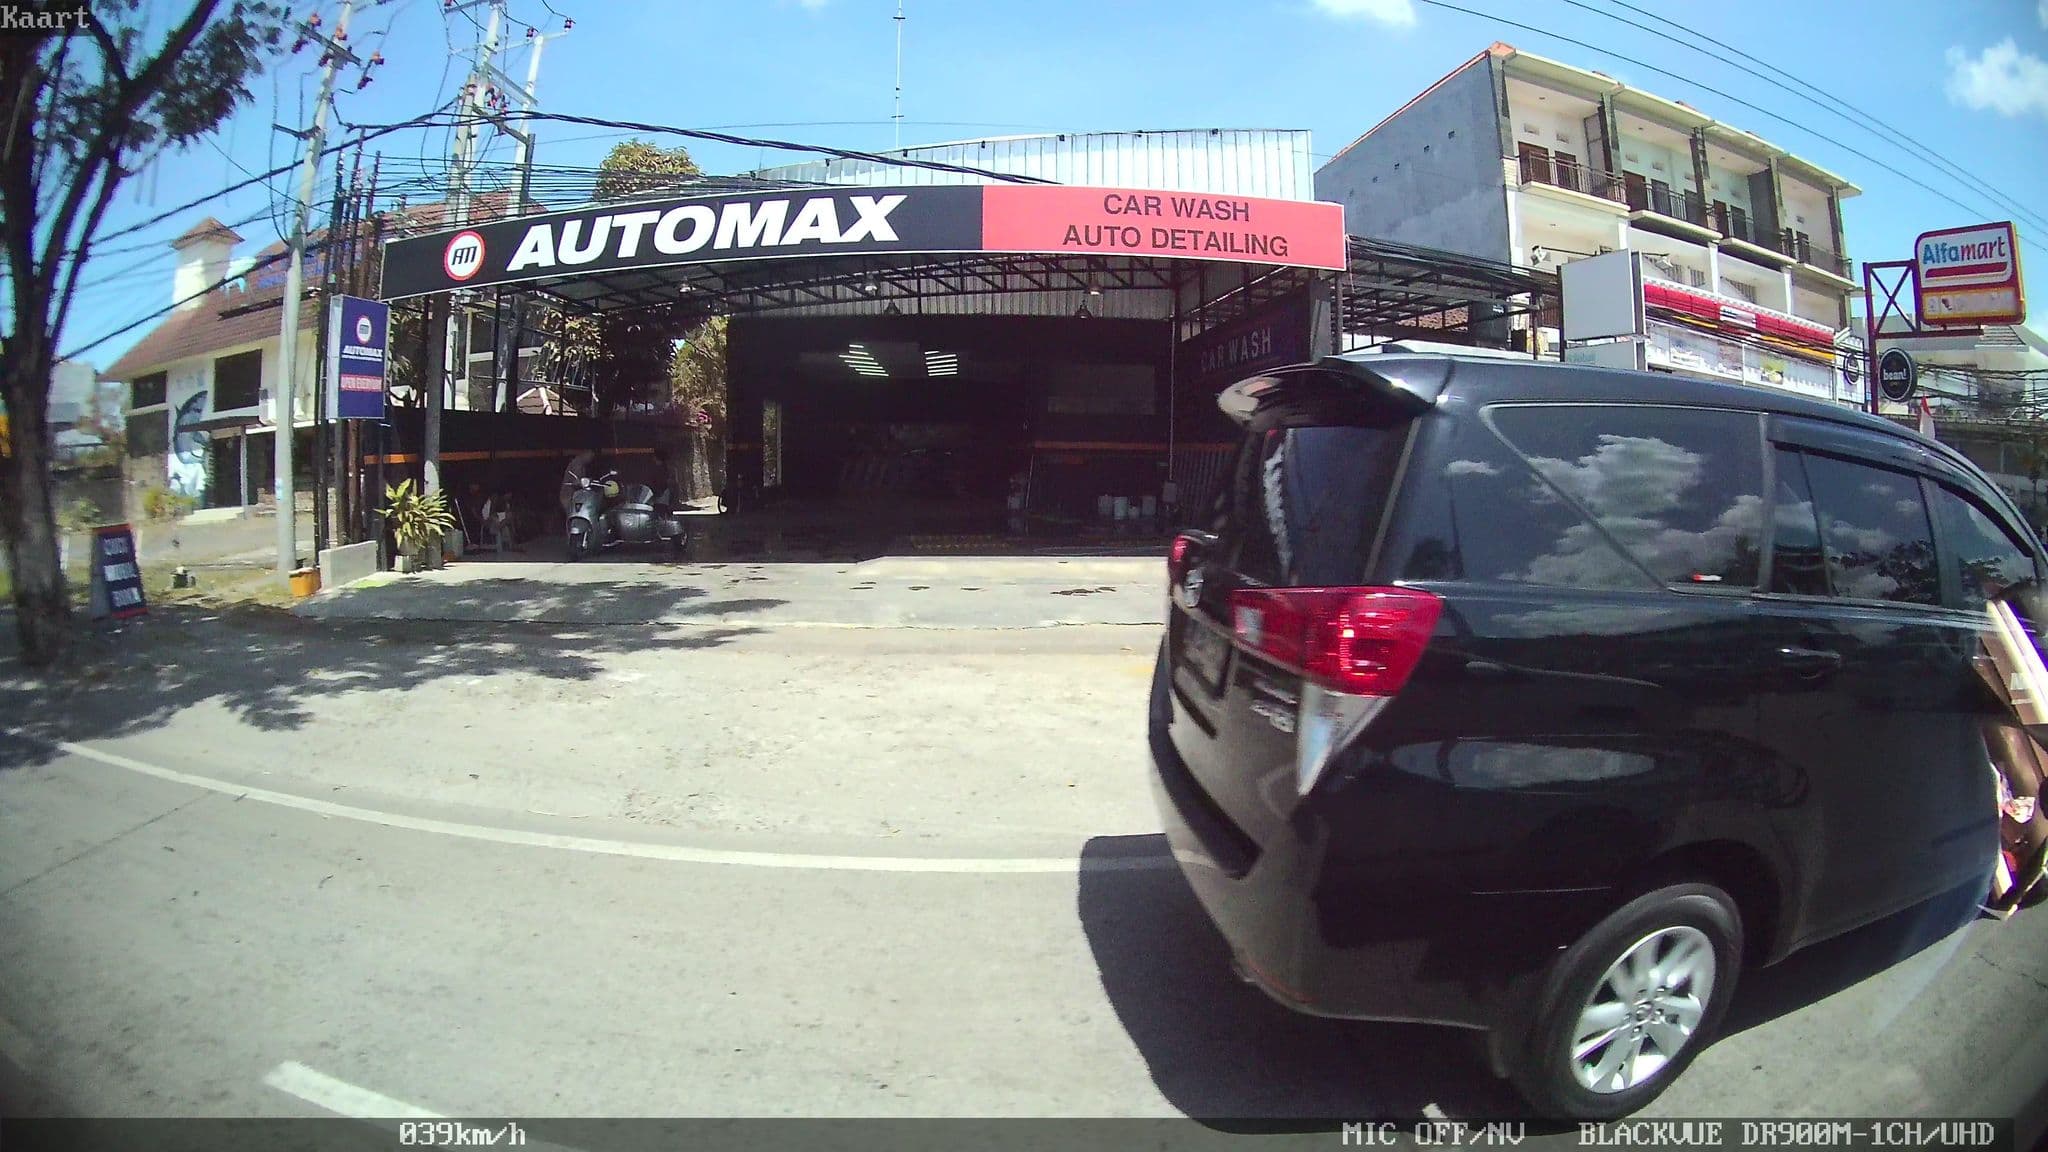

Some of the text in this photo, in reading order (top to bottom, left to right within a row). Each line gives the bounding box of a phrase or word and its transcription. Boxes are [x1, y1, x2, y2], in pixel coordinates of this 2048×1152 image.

[1103, 193, 1250, 222] CAR WASH
[506, 195, 908, 272] AUTOMAX
[1063, 224, 1288, 257] AUTO DETAILING
[1922, 236, 2006, 265] Alfamart
[1229, 327, 1271, 363] WASH
